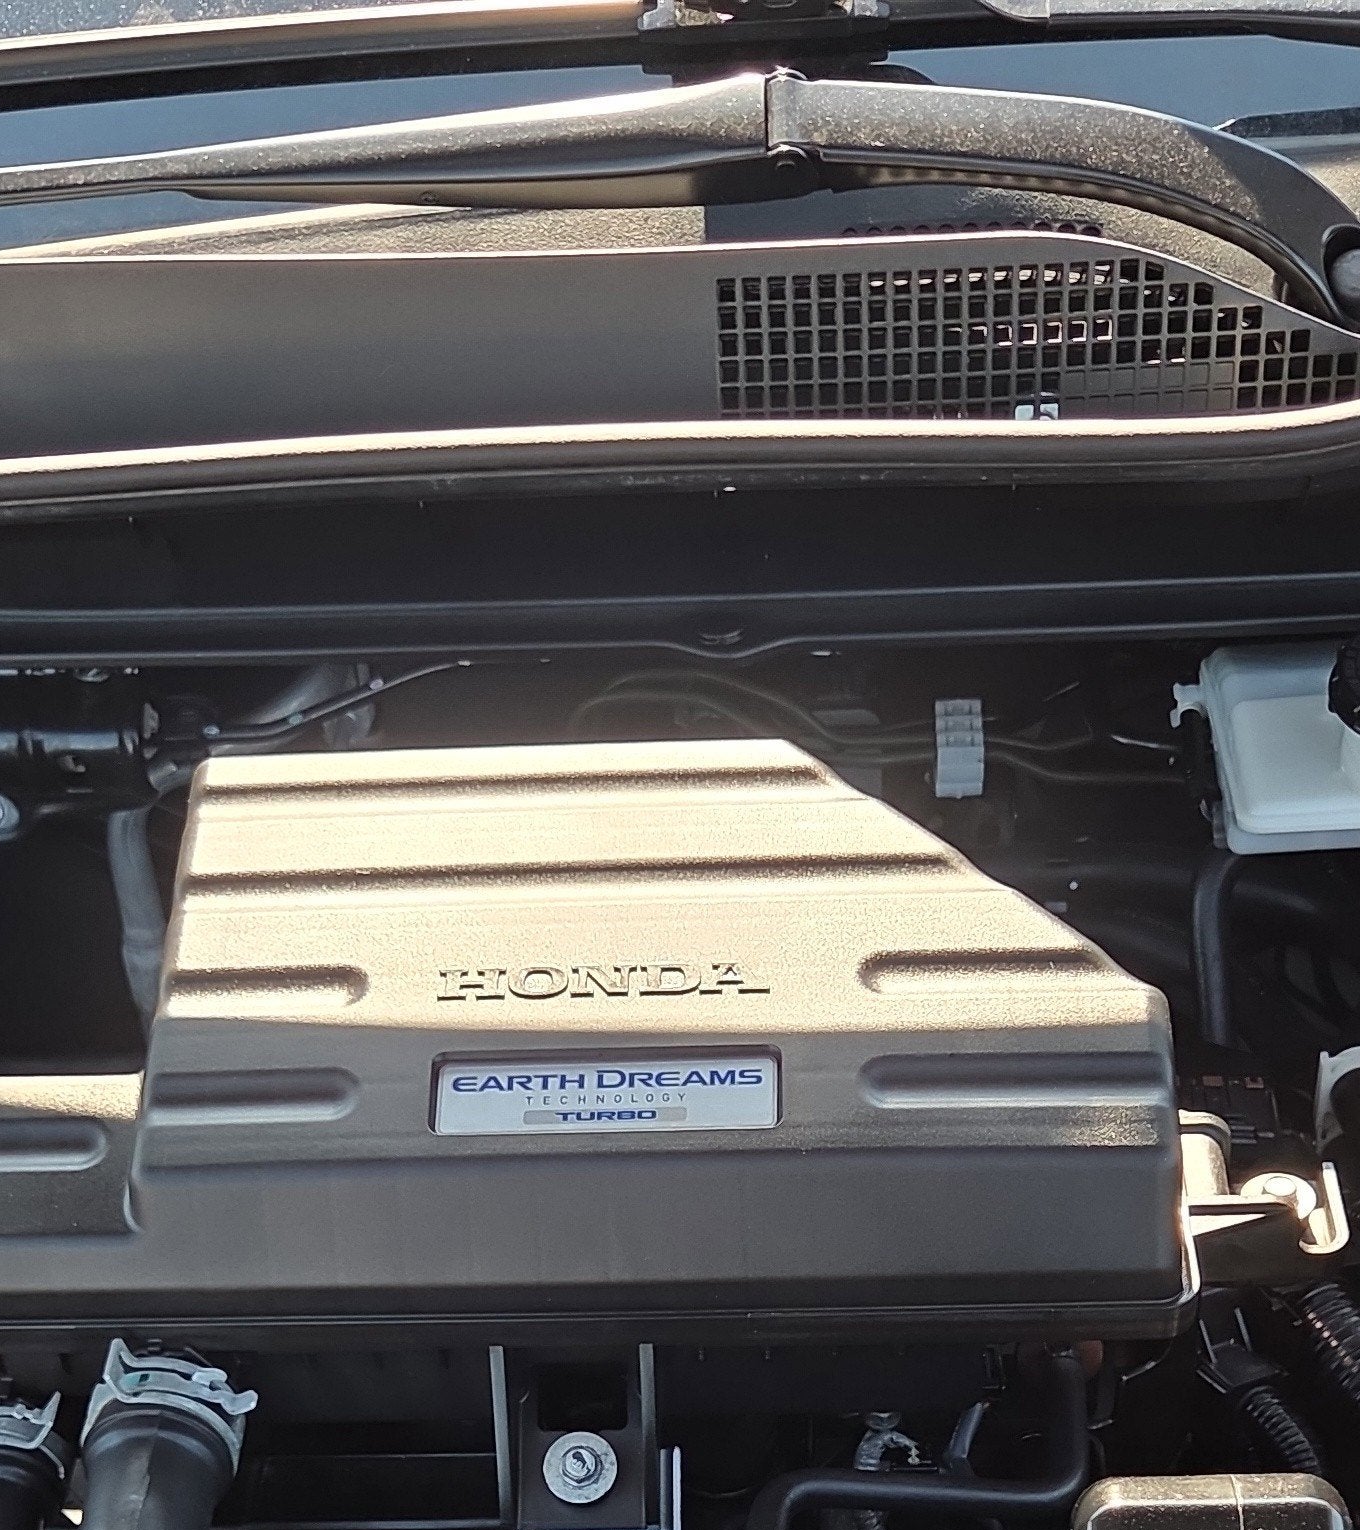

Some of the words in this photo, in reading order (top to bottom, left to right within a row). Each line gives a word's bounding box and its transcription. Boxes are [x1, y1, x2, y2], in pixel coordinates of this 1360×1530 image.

[437, 962, 771, 1001] HONDA
[452, 1073, 585, 1093] EARTH
[596, 1068, 763, 1090] DREAMS
[525, 1092, 687, 1106] TECHNOLOGY
[555, 1109, 657, 1122] TURBO
